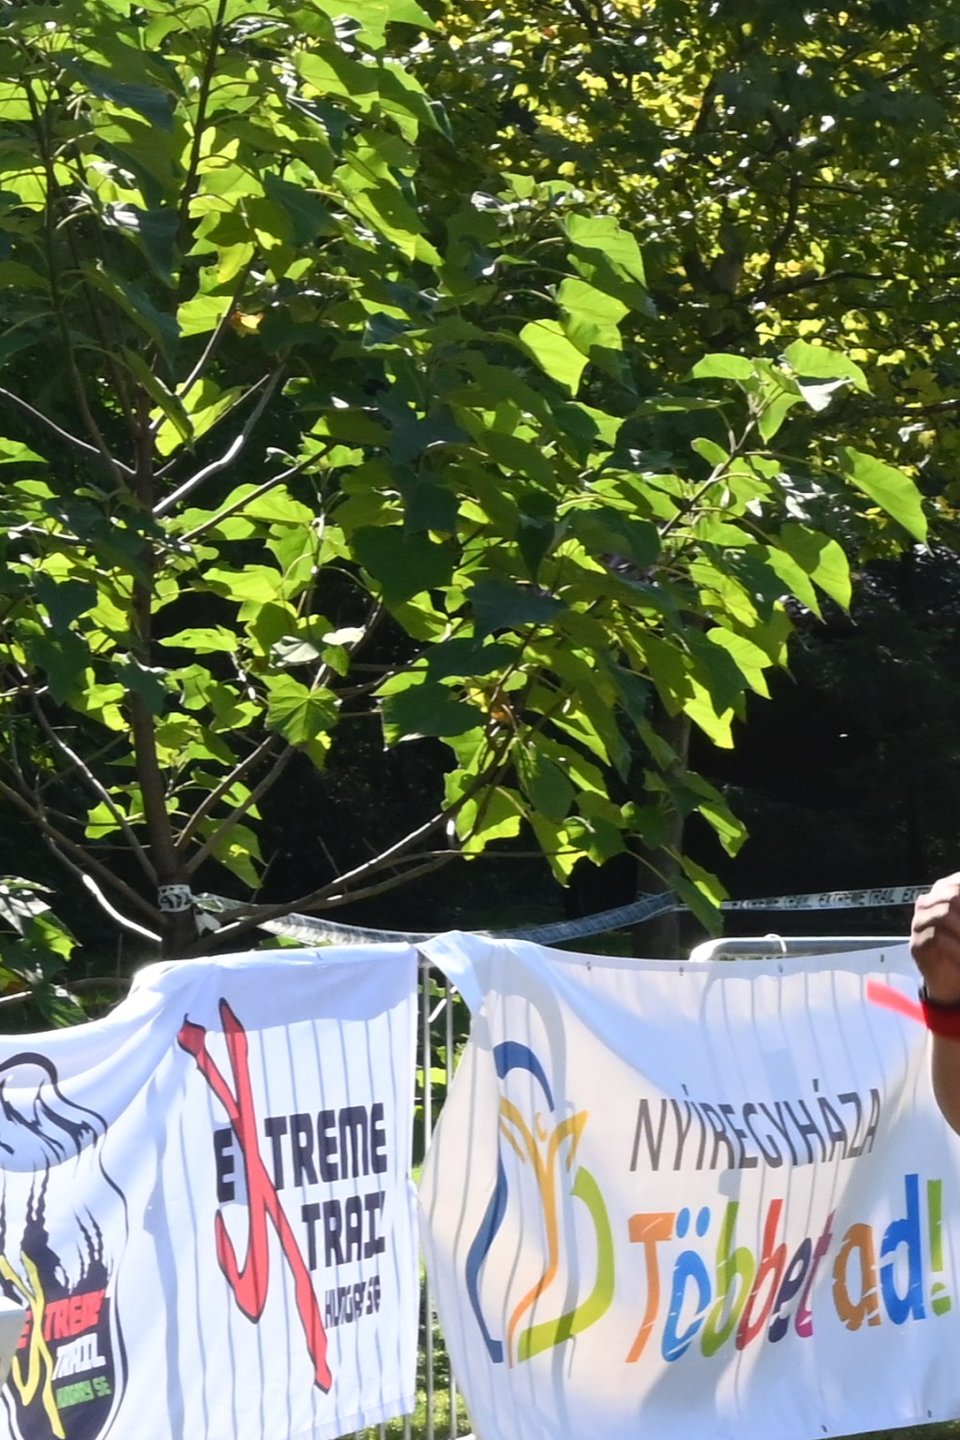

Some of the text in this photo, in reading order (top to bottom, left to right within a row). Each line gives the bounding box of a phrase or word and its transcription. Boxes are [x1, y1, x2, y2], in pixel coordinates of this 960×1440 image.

[629, 1078, 881, 1172] NYÍREGYHÁZA
[625, 1173, 952, 1363] Többet ad!
